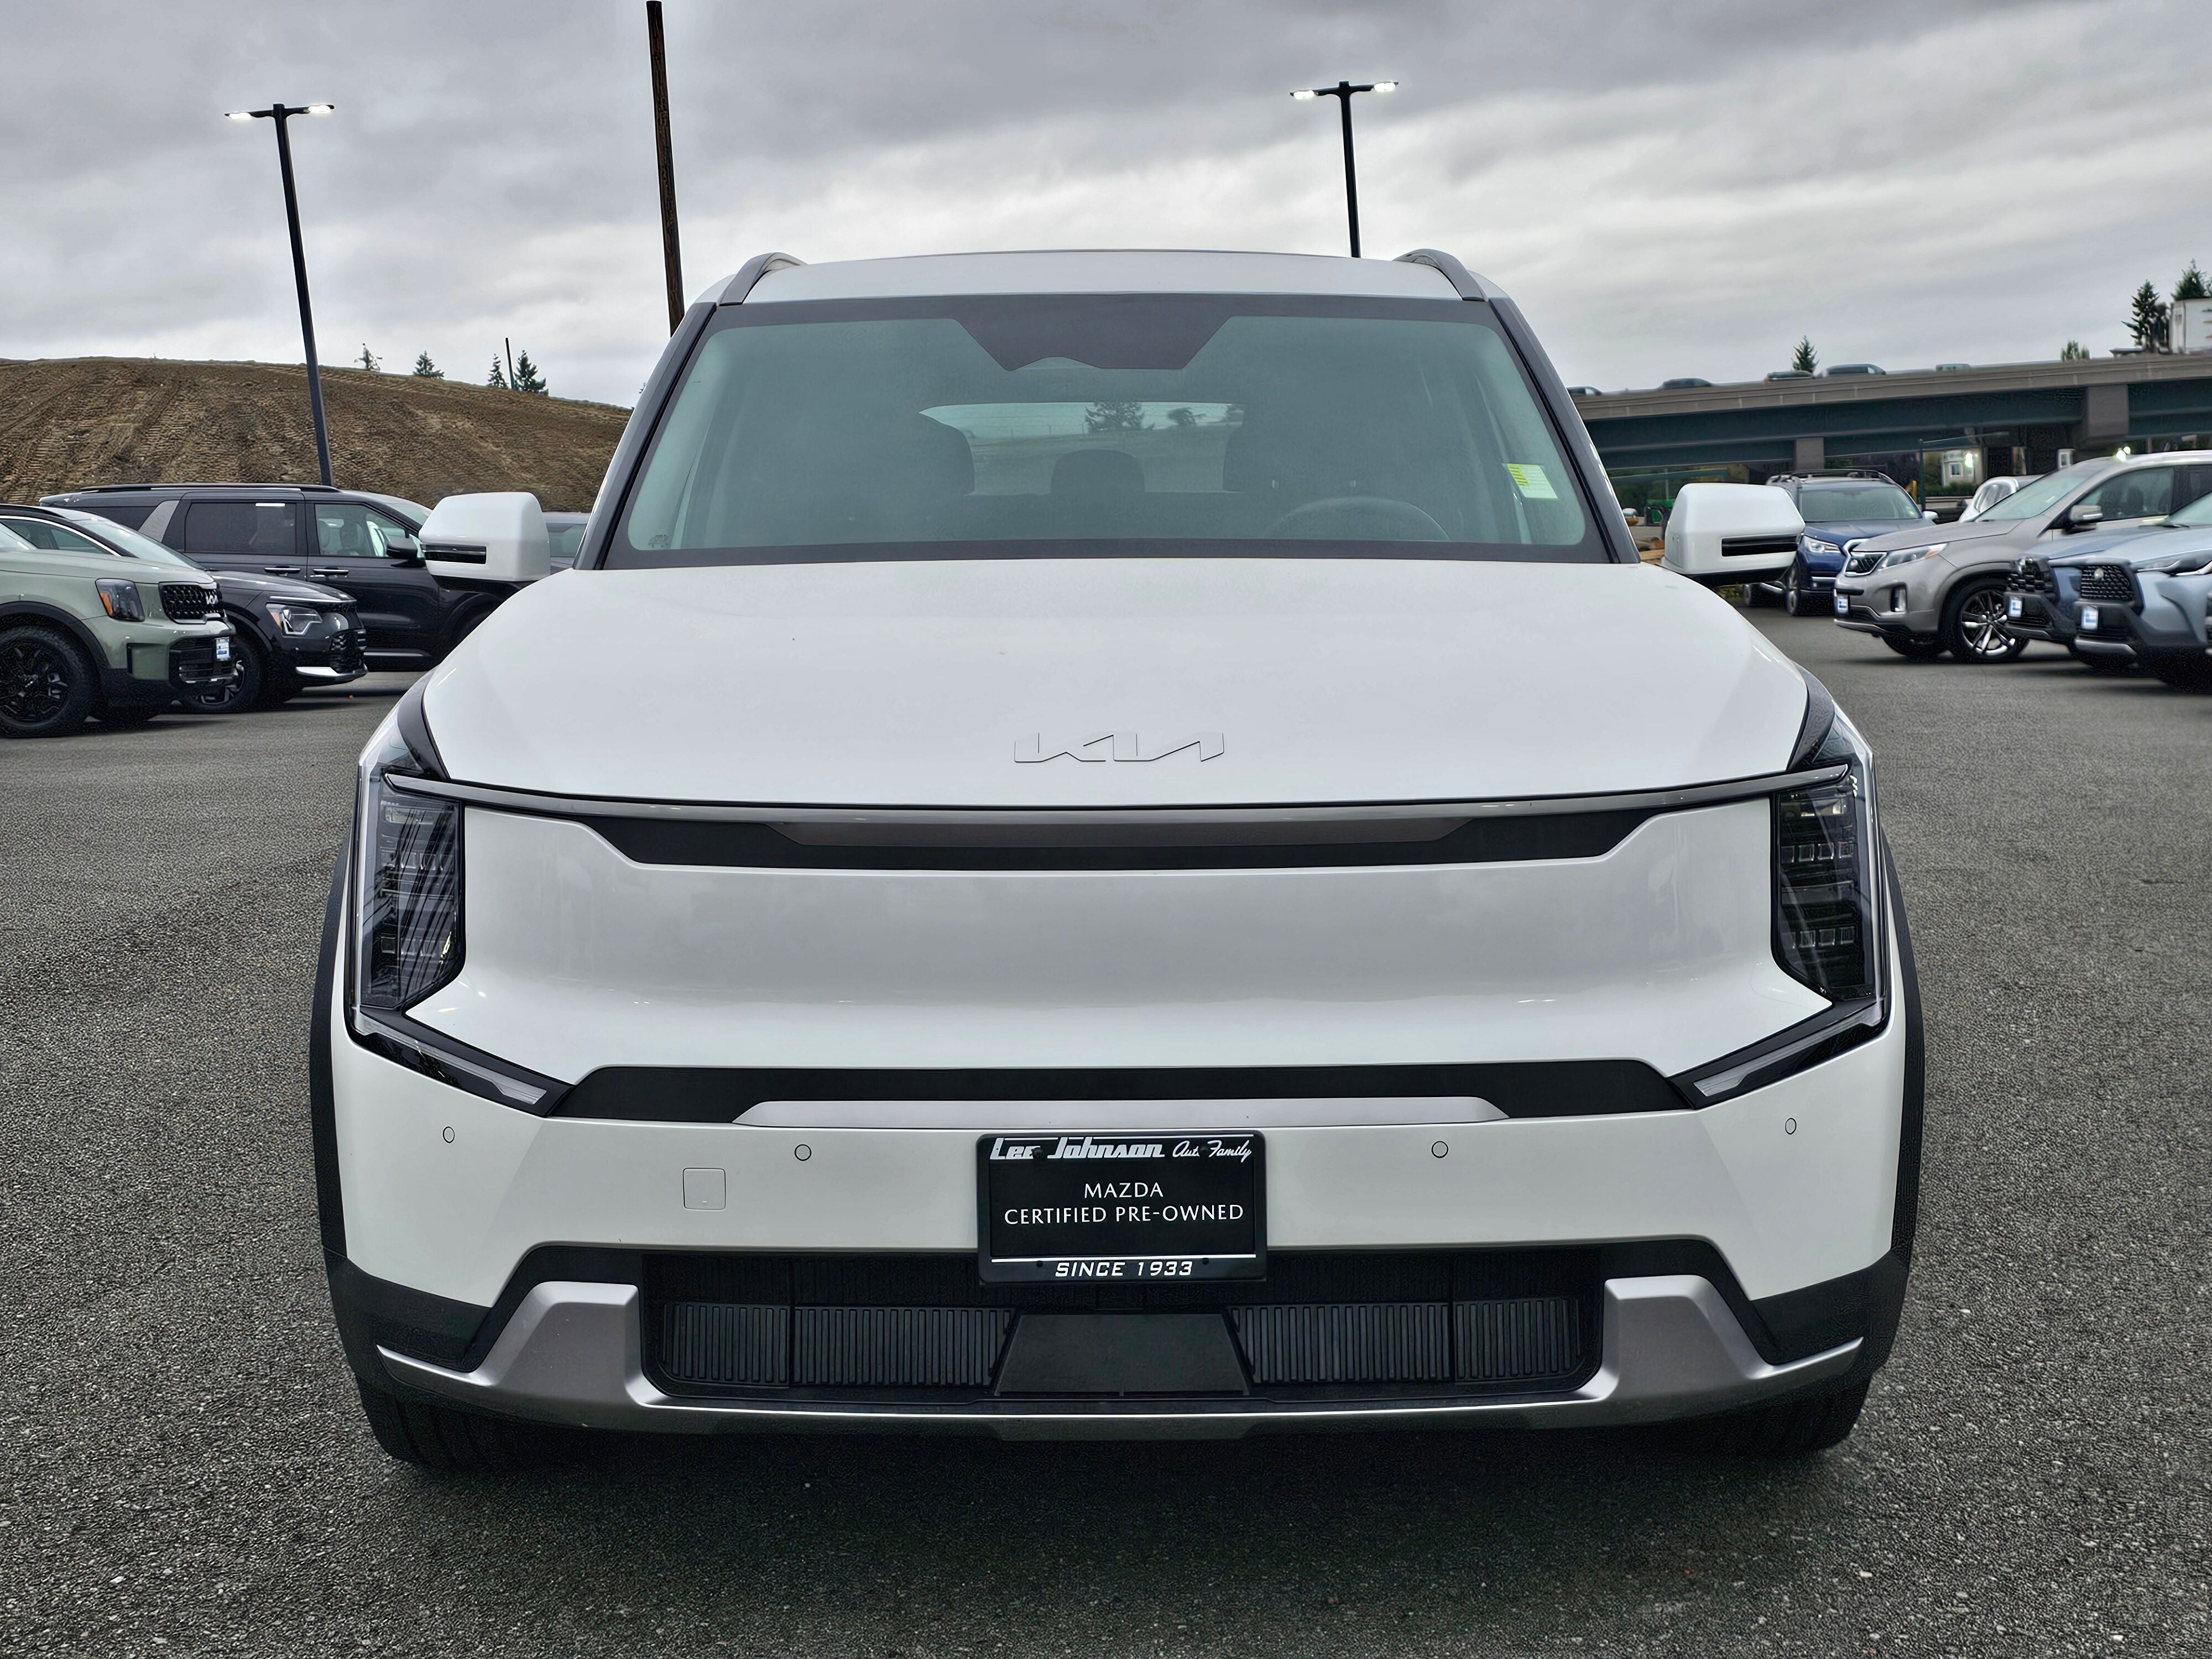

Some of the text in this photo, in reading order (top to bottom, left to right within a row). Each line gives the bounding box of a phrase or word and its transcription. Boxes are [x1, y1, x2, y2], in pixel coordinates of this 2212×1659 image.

[1047, 1137, 1165, 1159] Johnson
[1207, 1140, 1252, 1162] Family
[1084, 1182, 1164, 1198] MAZDA
[1004, 1204, 1244, 1224] CERTIFIED PRE-OWNED
[1055, 1261, 1193, 1277] SINCE 1933
